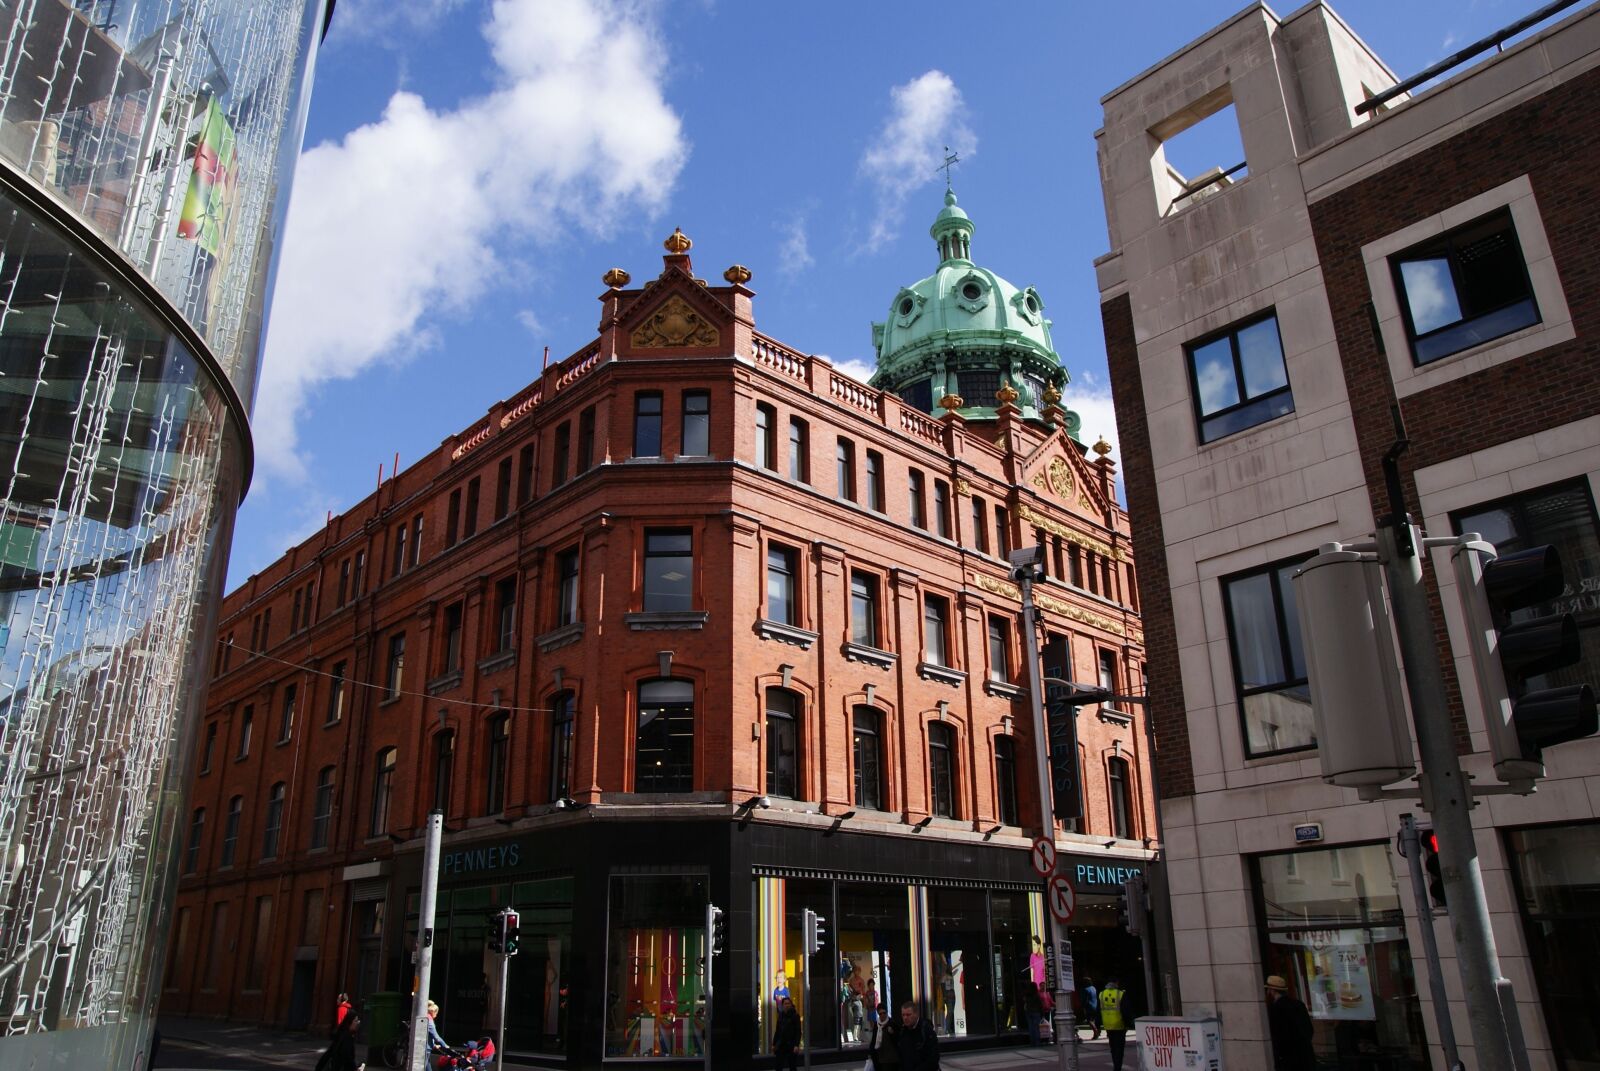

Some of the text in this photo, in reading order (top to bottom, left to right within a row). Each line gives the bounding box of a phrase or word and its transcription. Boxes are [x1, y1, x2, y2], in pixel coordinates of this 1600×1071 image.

[1046, 667, 1072, 792] PENNEYS
[444, 843, 520, 874] PENNEYS
[1145, 1026, 1191, 1047] STRUMPET
[1154, 1047, 1173, 1068] CITY
